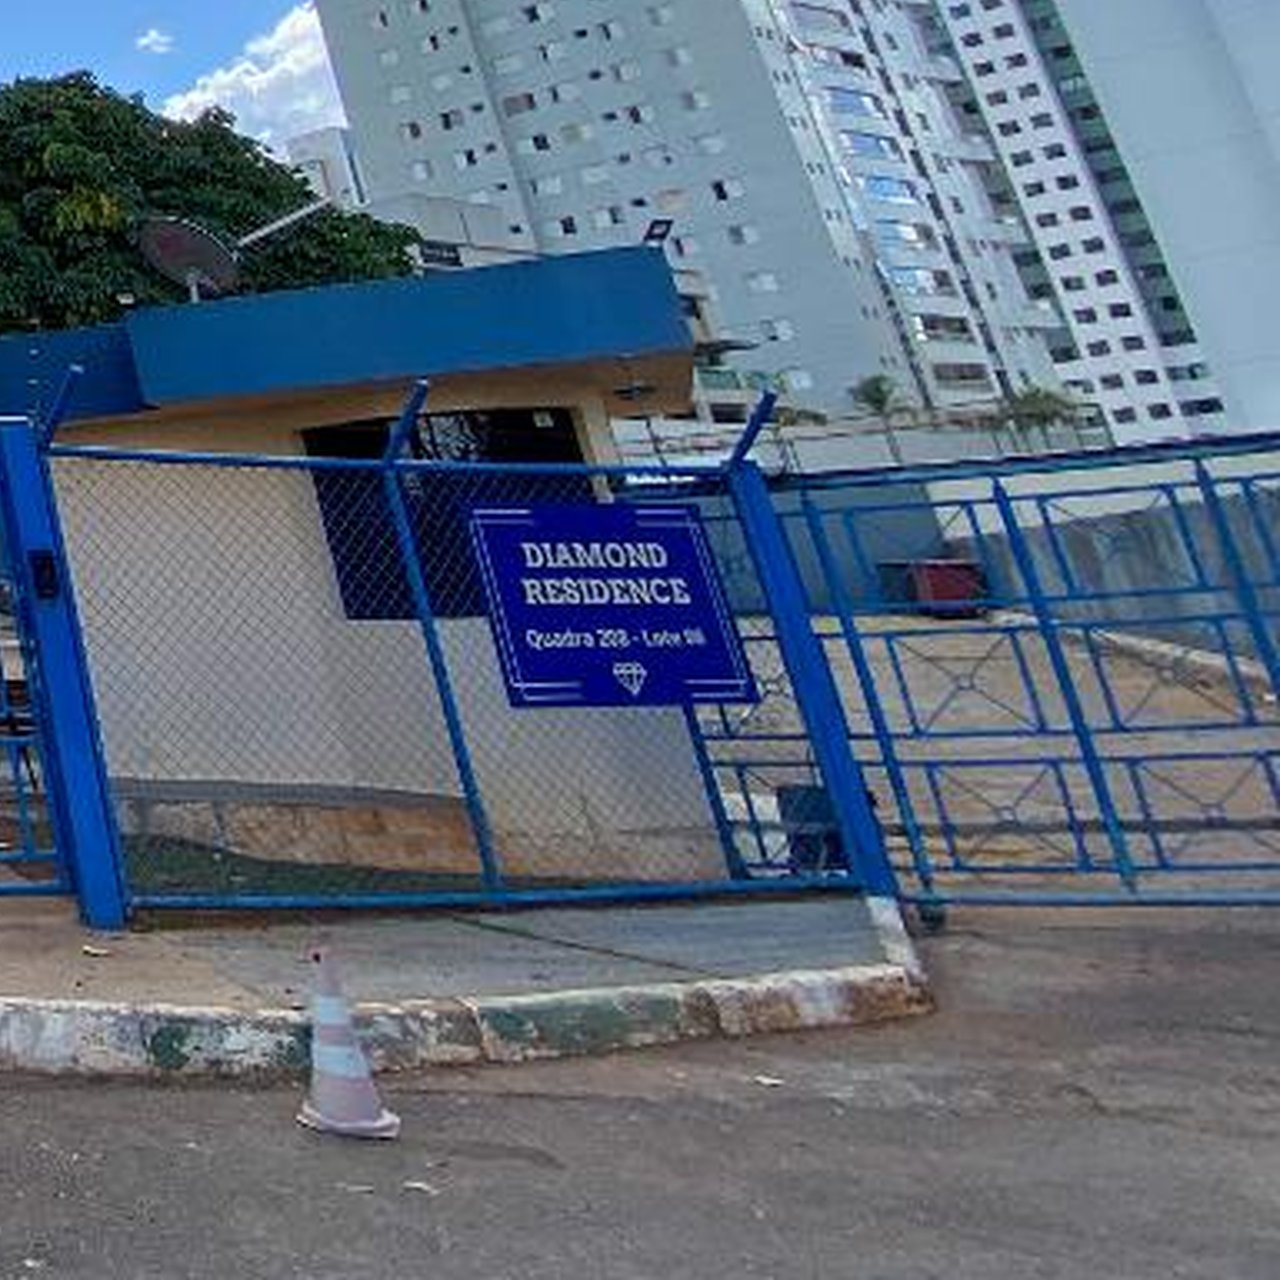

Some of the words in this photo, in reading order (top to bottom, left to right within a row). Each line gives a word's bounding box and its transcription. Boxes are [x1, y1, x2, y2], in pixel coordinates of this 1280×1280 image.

[521, 542, 668, 568] DIAMOND
[521, 578, 692, 605] RESIDENCE
[525, 626, 595, 651] Quadra
